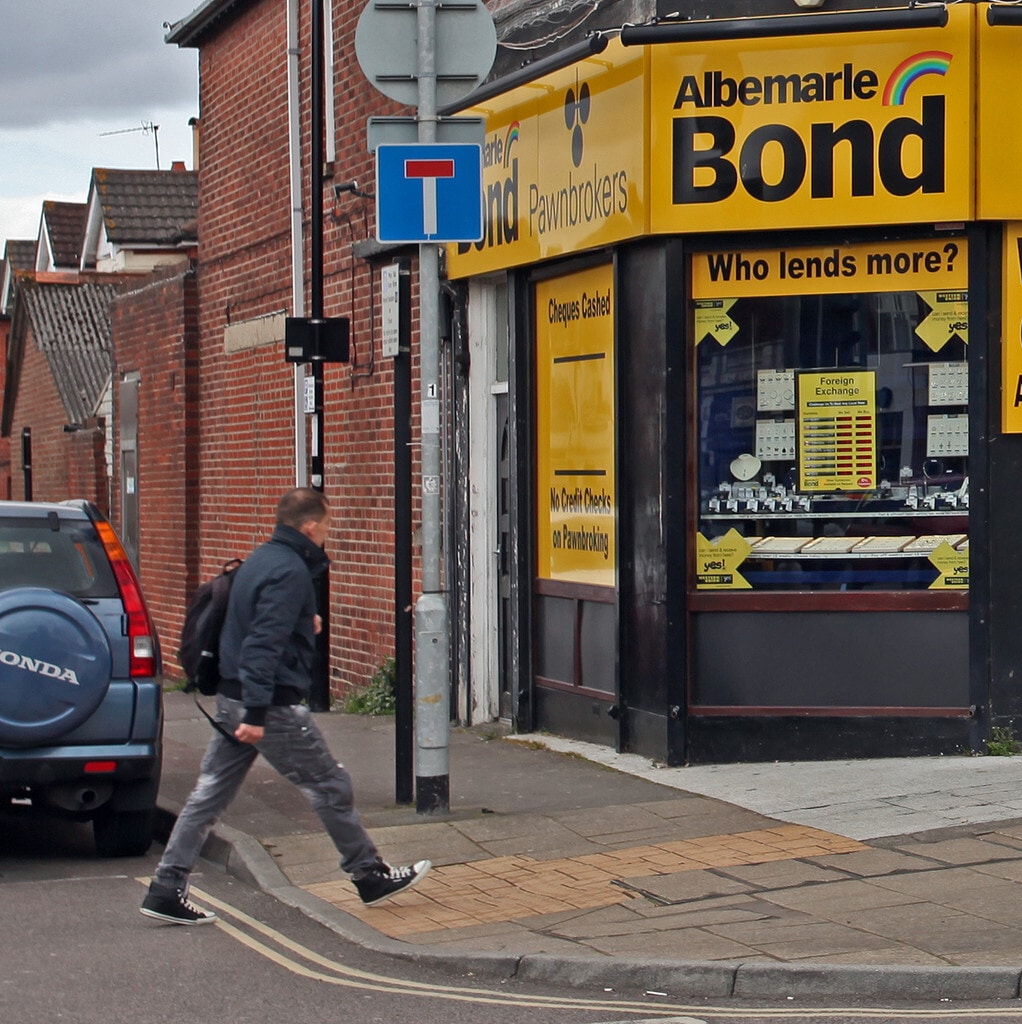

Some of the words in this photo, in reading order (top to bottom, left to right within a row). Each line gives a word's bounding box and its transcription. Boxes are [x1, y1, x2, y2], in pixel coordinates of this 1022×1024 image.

[673, 63, 878, 110] Albemarle
[672, 95, 945, 205] Bond
[529, 163, 628, 237] Pawnbrokers
[707, 253, 769, 282] Who
[780, 249, 857, 279] lends
[867, 243, 959, 275] more?
[549, 298, 580, 328] Cheques
[582, 288, 611, 319] Cashed
[715, 321, 732, 332] yes!
[429, 384, 435, 396] 1
[816, 386, 860, 396] Exchange
[820, 376, 854, 386] Foreign
[551, 487, 560, 512] No
[562, 487, 583, 513] Credit
[585, 487, 611, 514] Checks
[553, 530, 561, 549] on
[563, 523, 608, 560] Pawnbroking
[704, 559, 725, 572] yes!
[0, 649, 80, 685] ONDA
